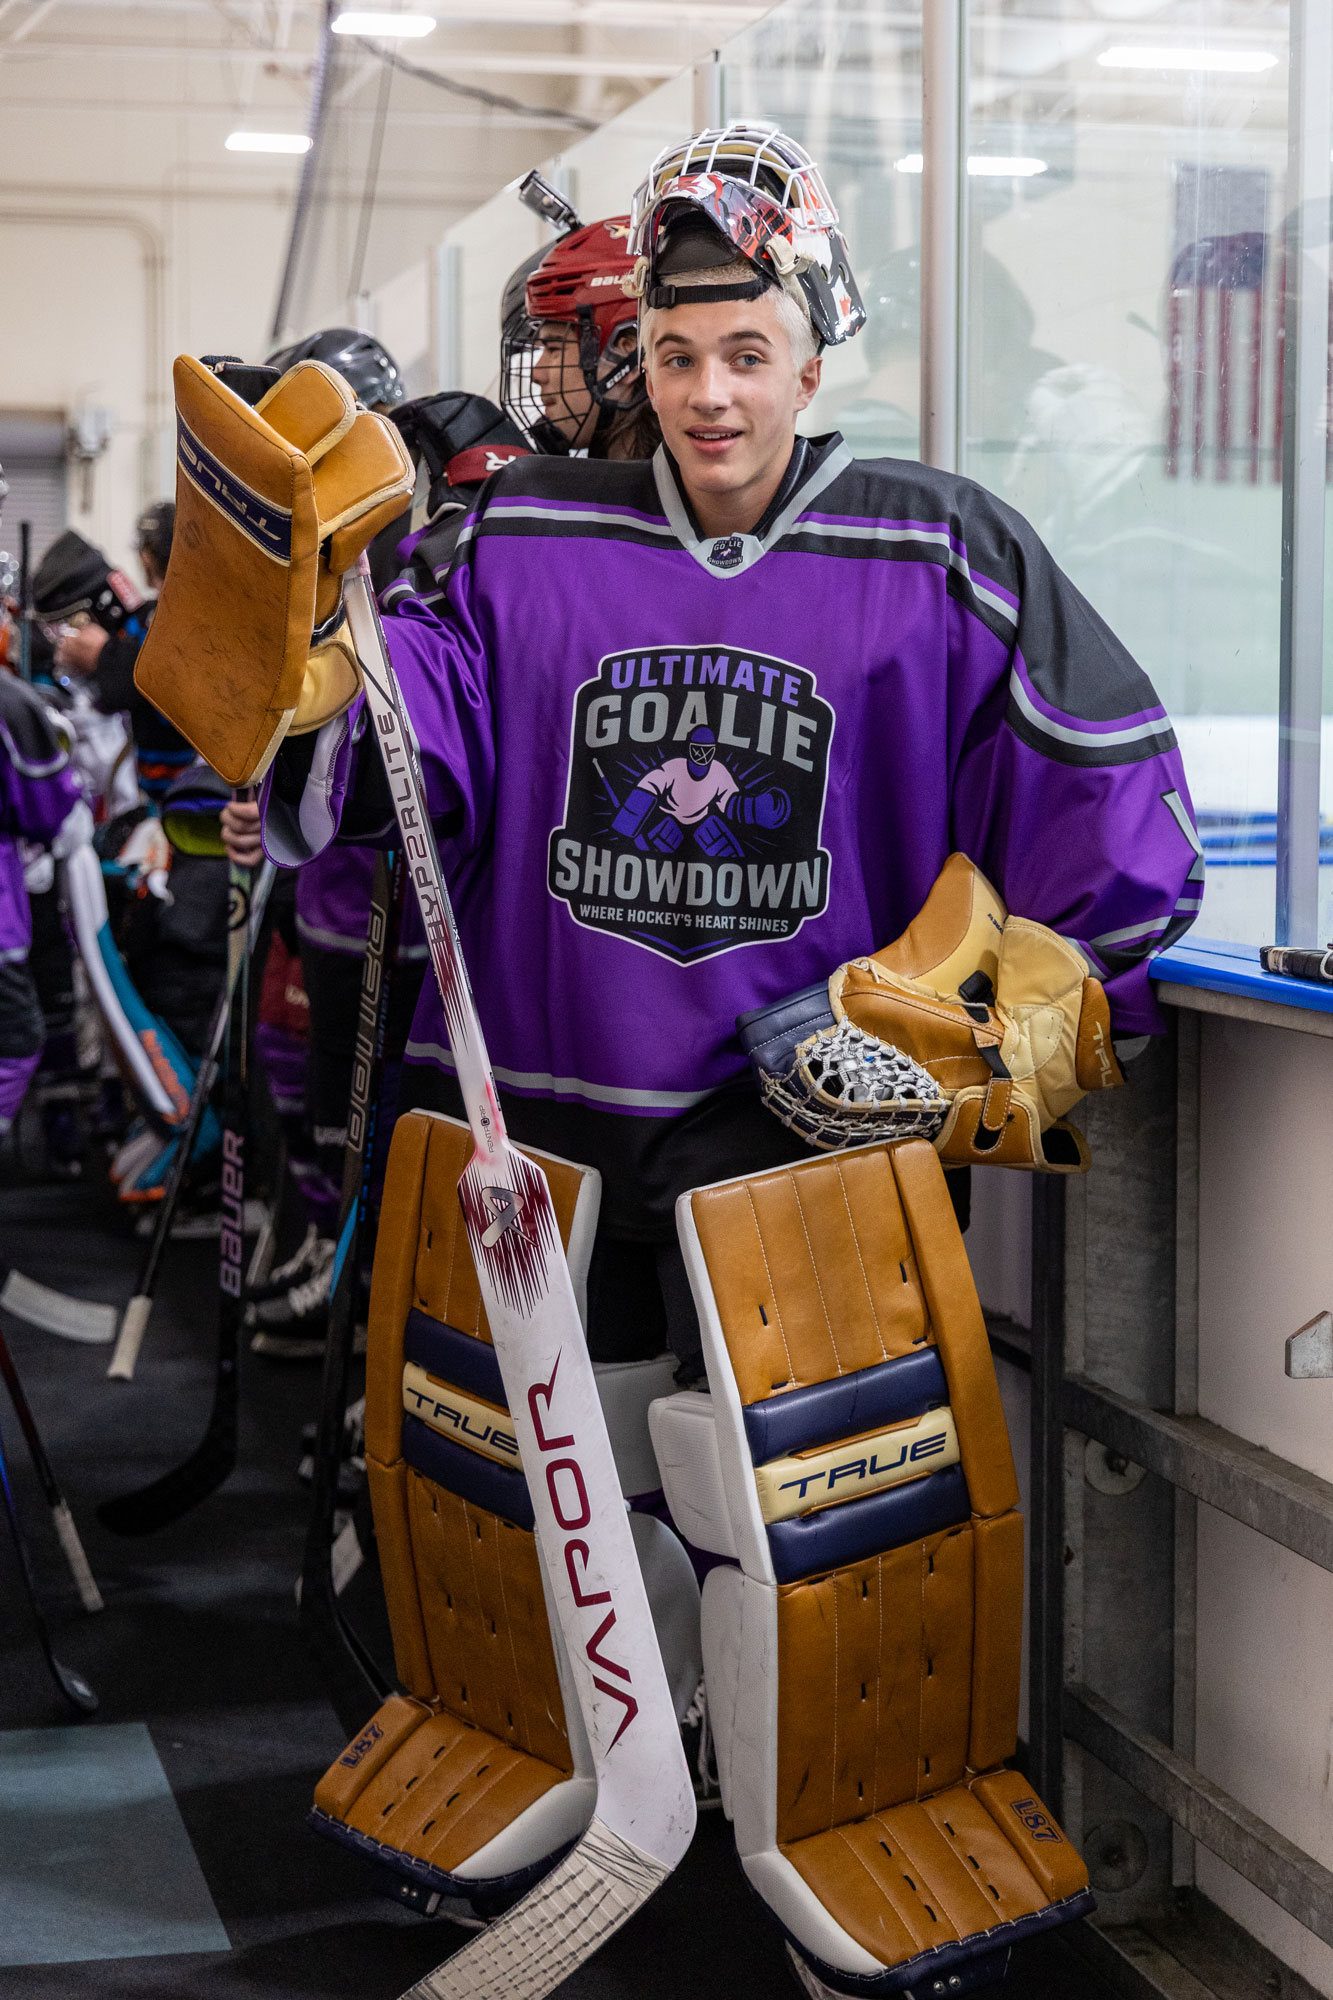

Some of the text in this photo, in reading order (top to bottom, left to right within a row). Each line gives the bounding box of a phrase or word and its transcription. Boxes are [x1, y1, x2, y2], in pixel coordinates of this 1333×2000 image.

[179, 434, 282, 541] TRUE
[611, 655, 801, 707] ULTIMATE
[585, 691, 818, 773] GOALIE
[555, 838, 822, 909] SHOWDOWN
[580, 903, 789, 933] WHERE HOCKEY'S HEART SHINES
[219, 1128, 245, 1298] BAUER
[406, 1387, 519, 1456] TRUE
[778, 1431, 947, 1499] TRUE
[527, 1346, 639, 1758] VAPOR
[1009, 1797, 1064, 1843] L87
